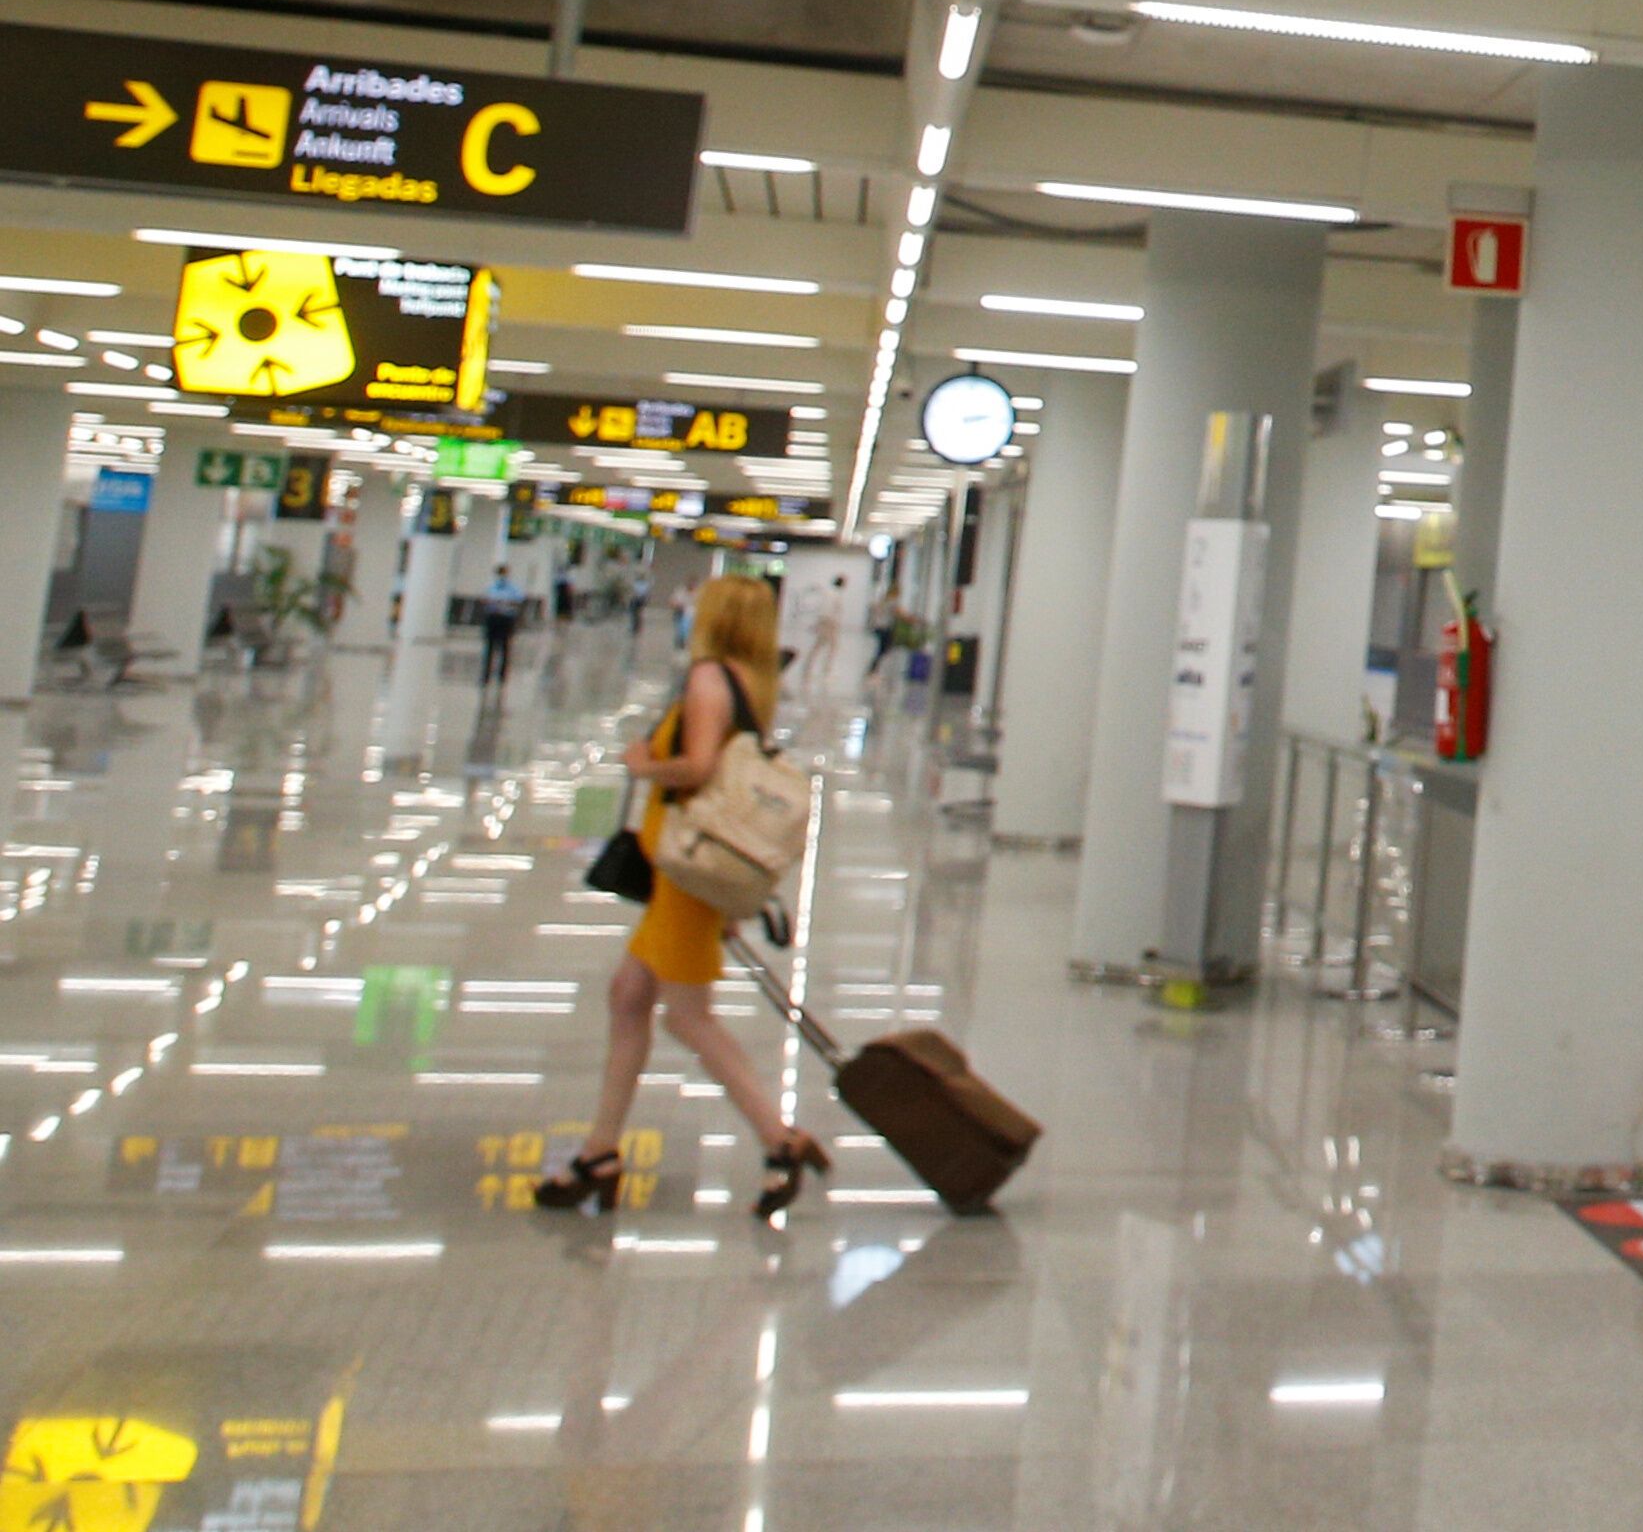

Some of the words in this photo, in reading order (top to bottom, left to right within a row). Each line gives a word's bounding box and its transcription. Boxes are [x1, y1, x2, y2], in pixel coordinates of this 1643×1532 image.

[304, 65, 463, 106] Arribades
[299, 97, 399, 132] Arrivals
[294, 129, 396, 165] Ankunft
[460, 102, 541, 196] C
[289, 164, 438, 203] Llegadas
[685, 410, 748, 451] AB
